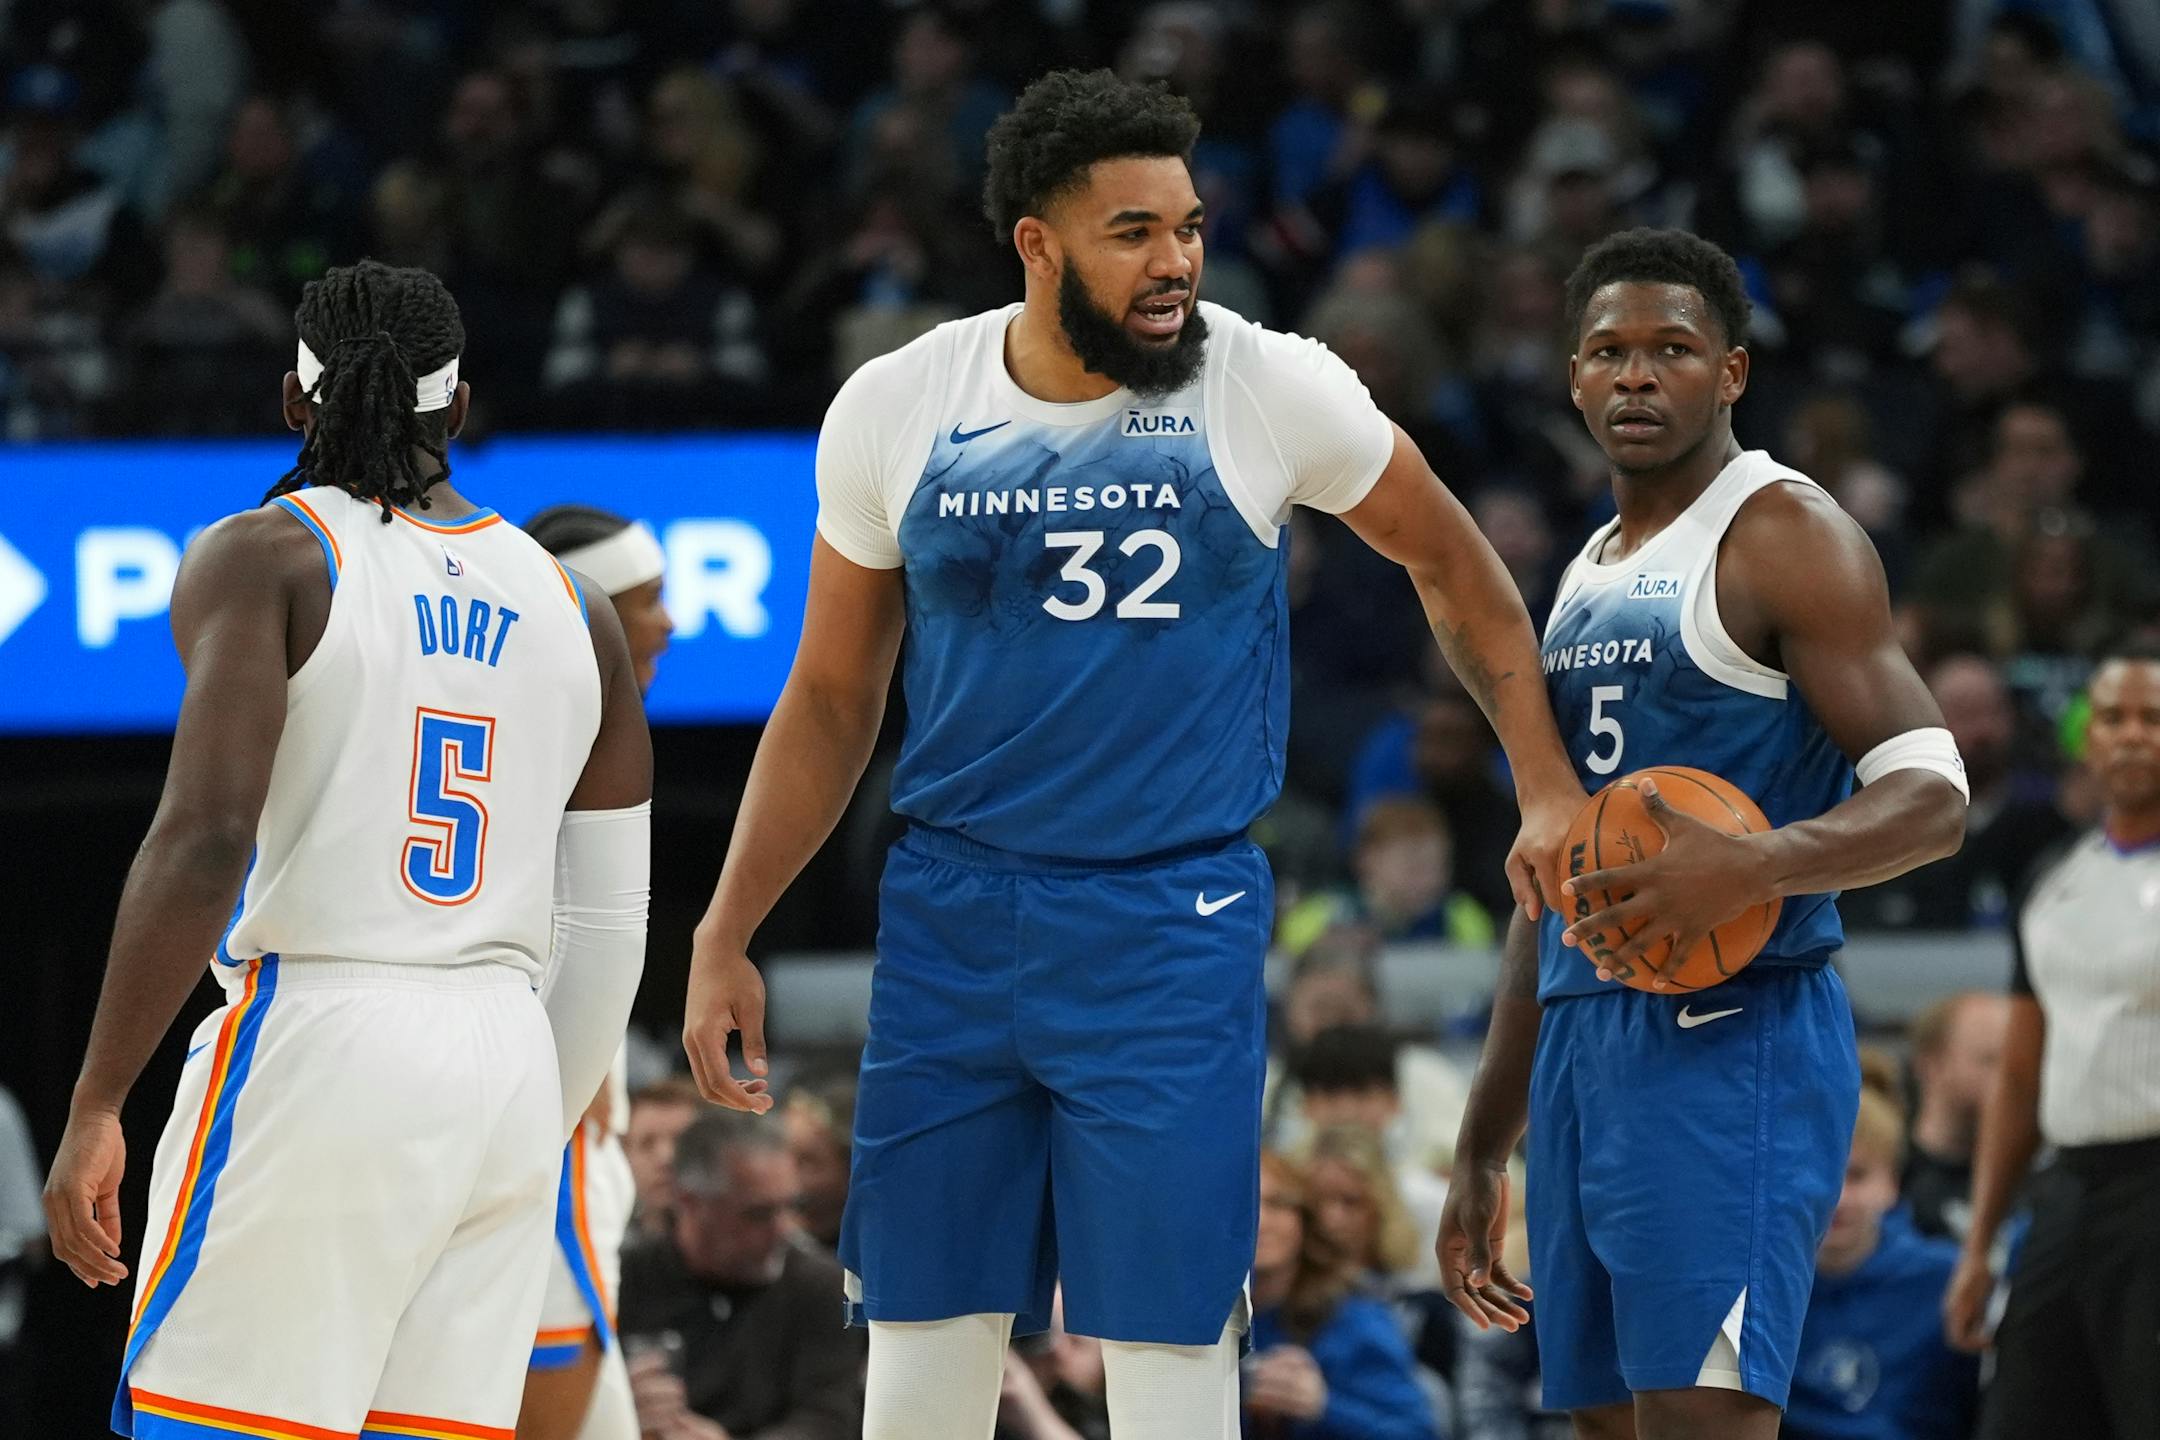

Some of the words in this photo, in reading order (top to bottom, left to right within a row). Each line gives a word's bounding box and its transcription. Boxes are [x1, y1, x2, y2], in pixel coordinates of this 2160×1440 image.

[939, 484, 1181, 517] MINNESOTA
[1042, 529, 1182, 621] 32
[414, 594, 520, 667] DORT
[1586, 685, 1624, 774] 5
[401, 706, 496, 906] 5
